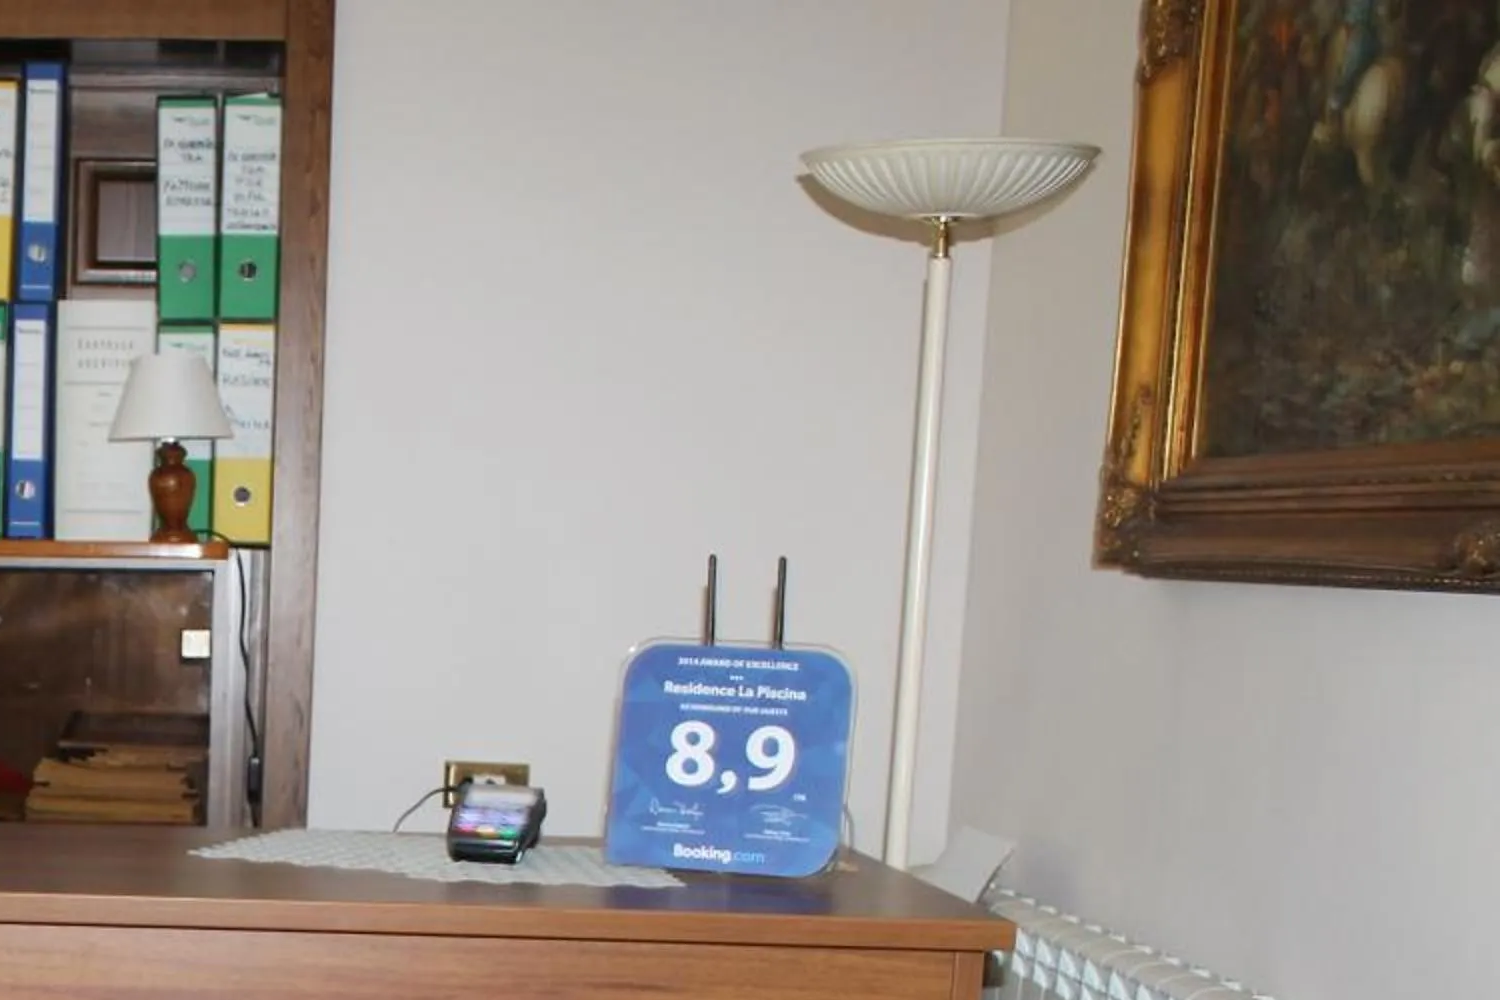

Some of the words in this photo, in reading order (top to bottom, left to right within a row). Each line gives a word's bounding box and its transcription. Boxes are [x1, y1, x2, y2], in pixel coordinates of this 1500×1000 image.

[700, 658, 731, 669] AWARD
[732, 659, 745, 669] OF
[746, 660, 800, 672] EXCELLENCE
[663, 680, 737, 698] Residence
[738, 684, 755, 698] La
[756, 686, 808, 702] Piscina
[664, 720, 797, 795] 8,9
[673, 842, 766, 865] Booking.com
